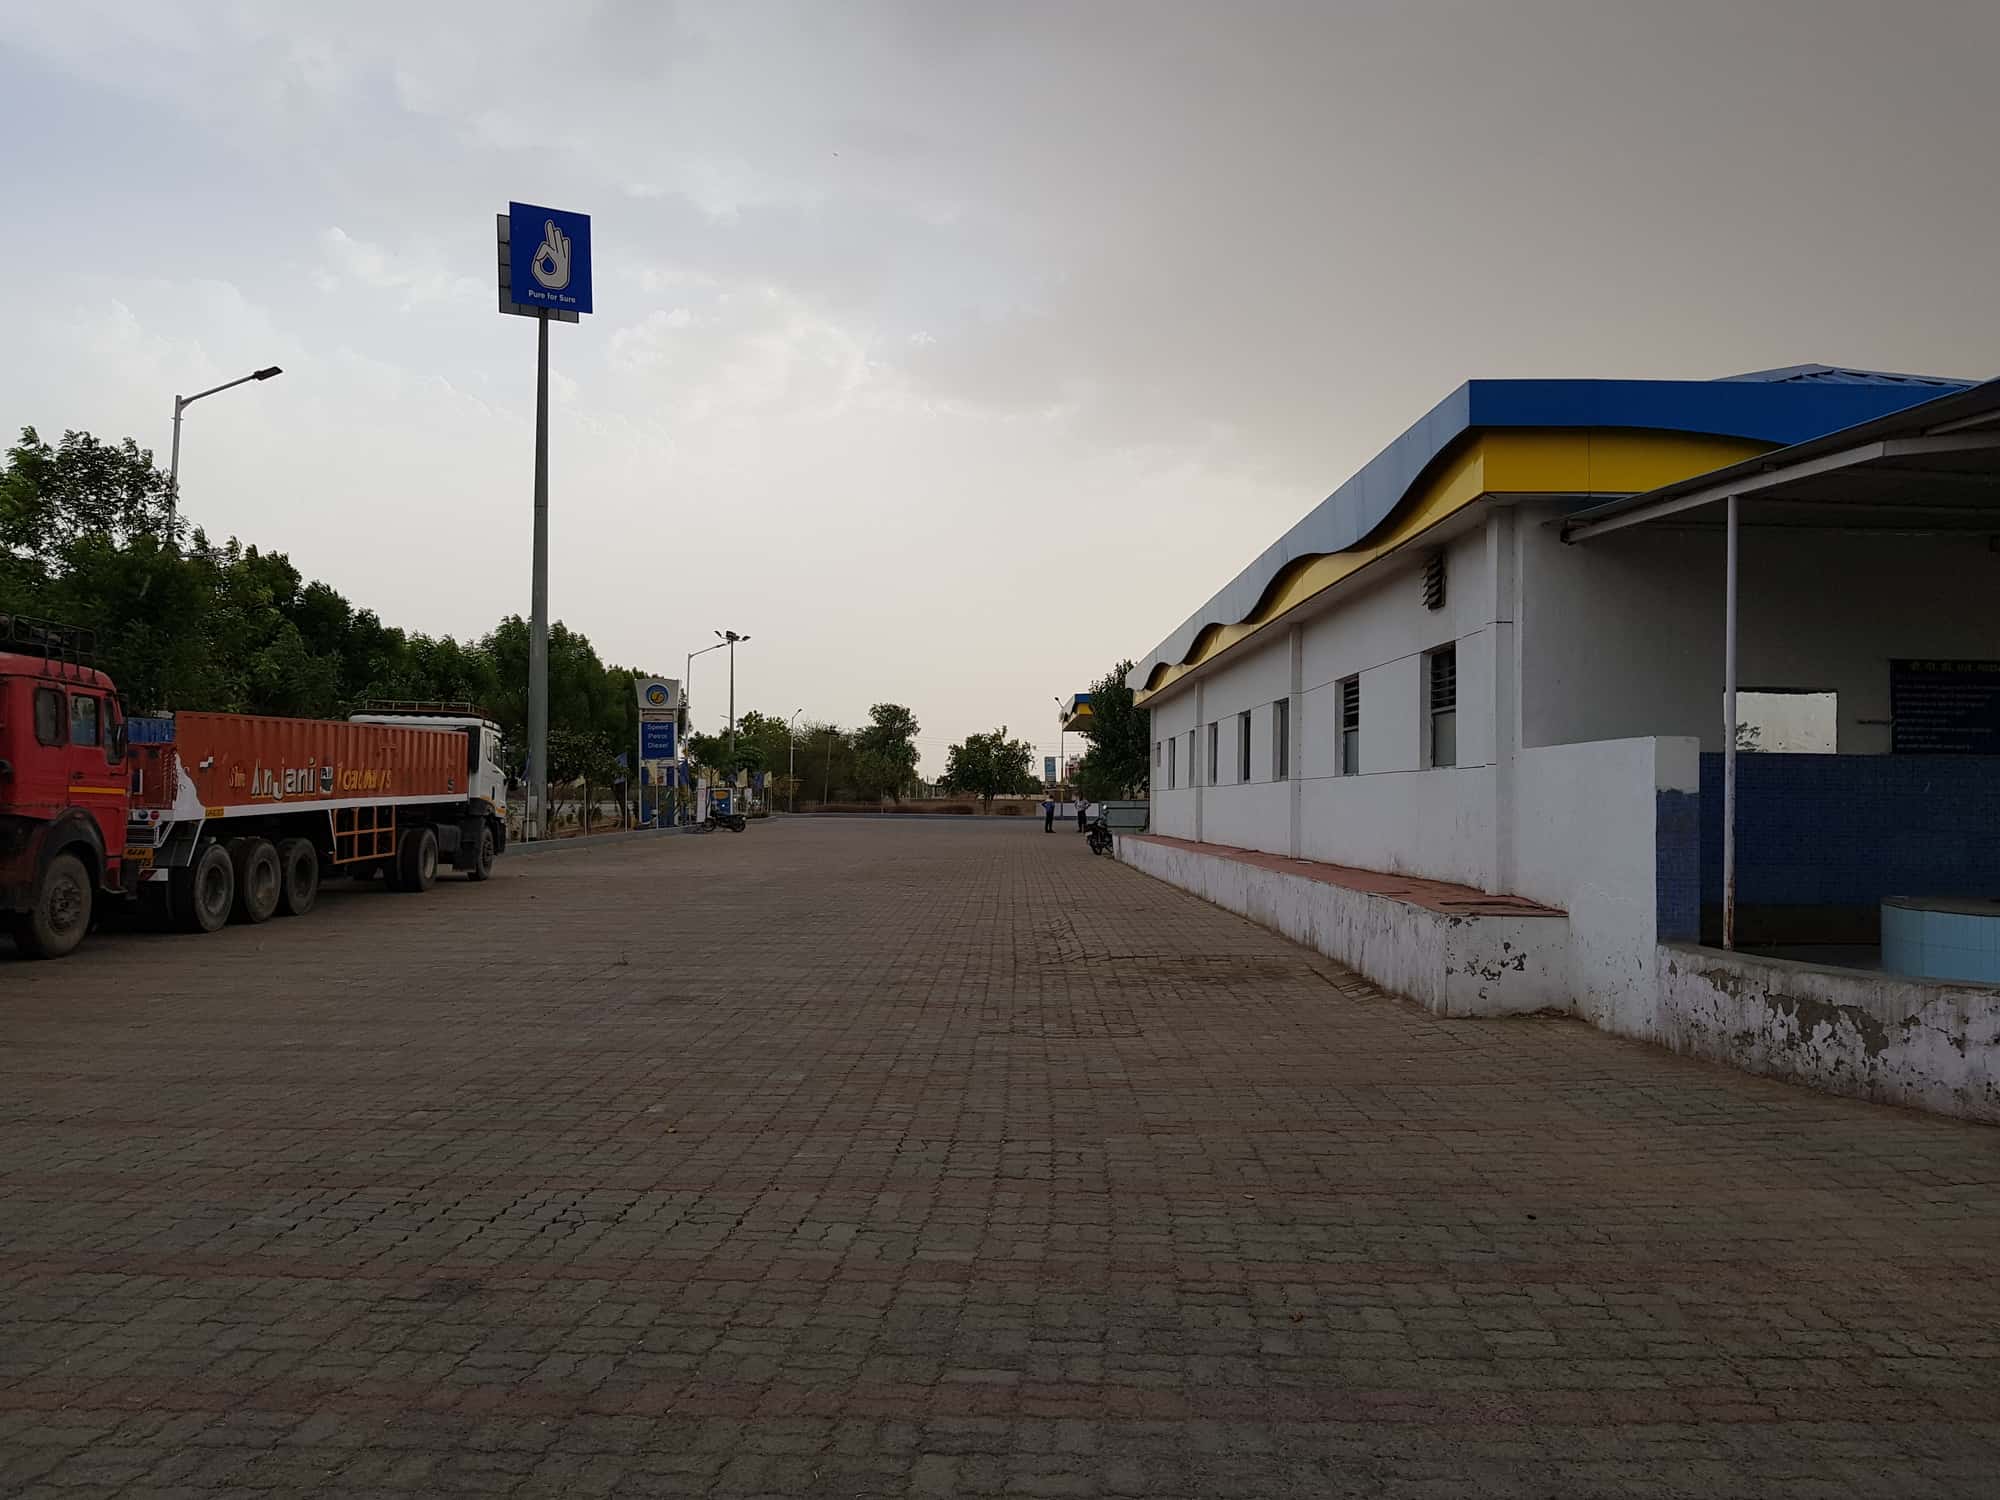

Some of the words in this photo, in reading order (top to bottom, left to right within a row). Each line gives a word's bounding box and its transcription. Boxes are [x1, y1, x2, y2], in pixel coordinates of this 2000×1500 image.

[528, 290, 546, 299] Pure
[547, 292, 558, 301] for
[559, 294, 576, 303] Sure
[251, 756, 316, 801] Anjani
